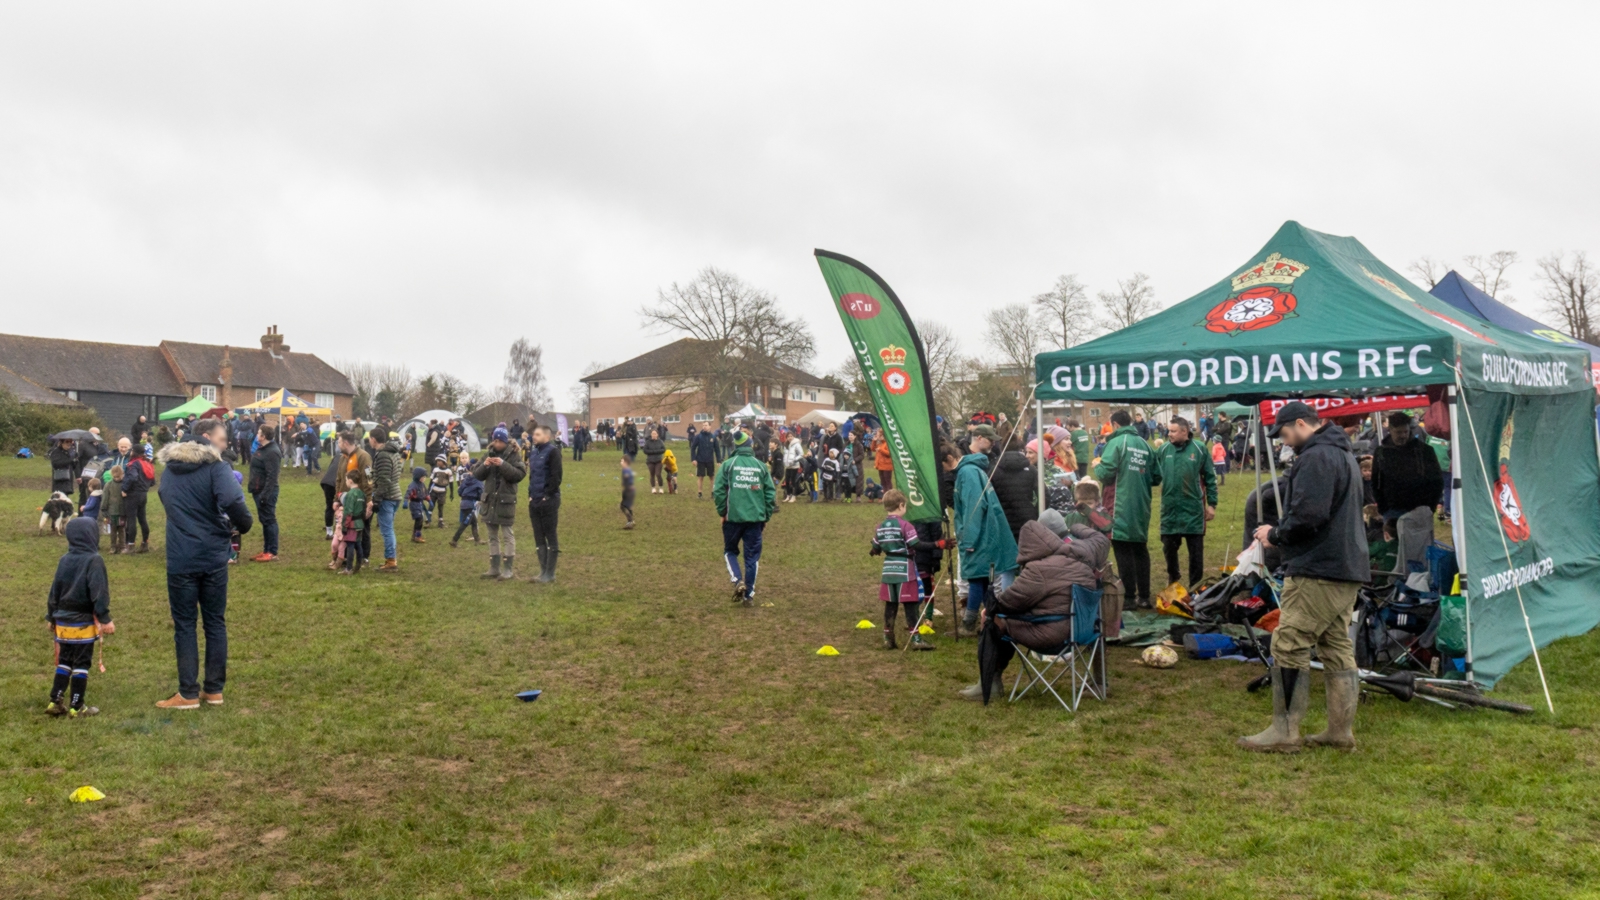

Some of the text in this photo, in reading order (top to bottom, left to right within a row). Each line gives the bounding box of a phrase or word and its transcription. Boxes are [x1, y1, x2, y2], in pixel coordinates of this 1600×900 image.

[1050, 344, 1434, 392] GUILDFORDIANS RFC
[1481, 352, 1553, 387] GUILDFORDIANS
[1552, 361, 1569, 386] RFC
